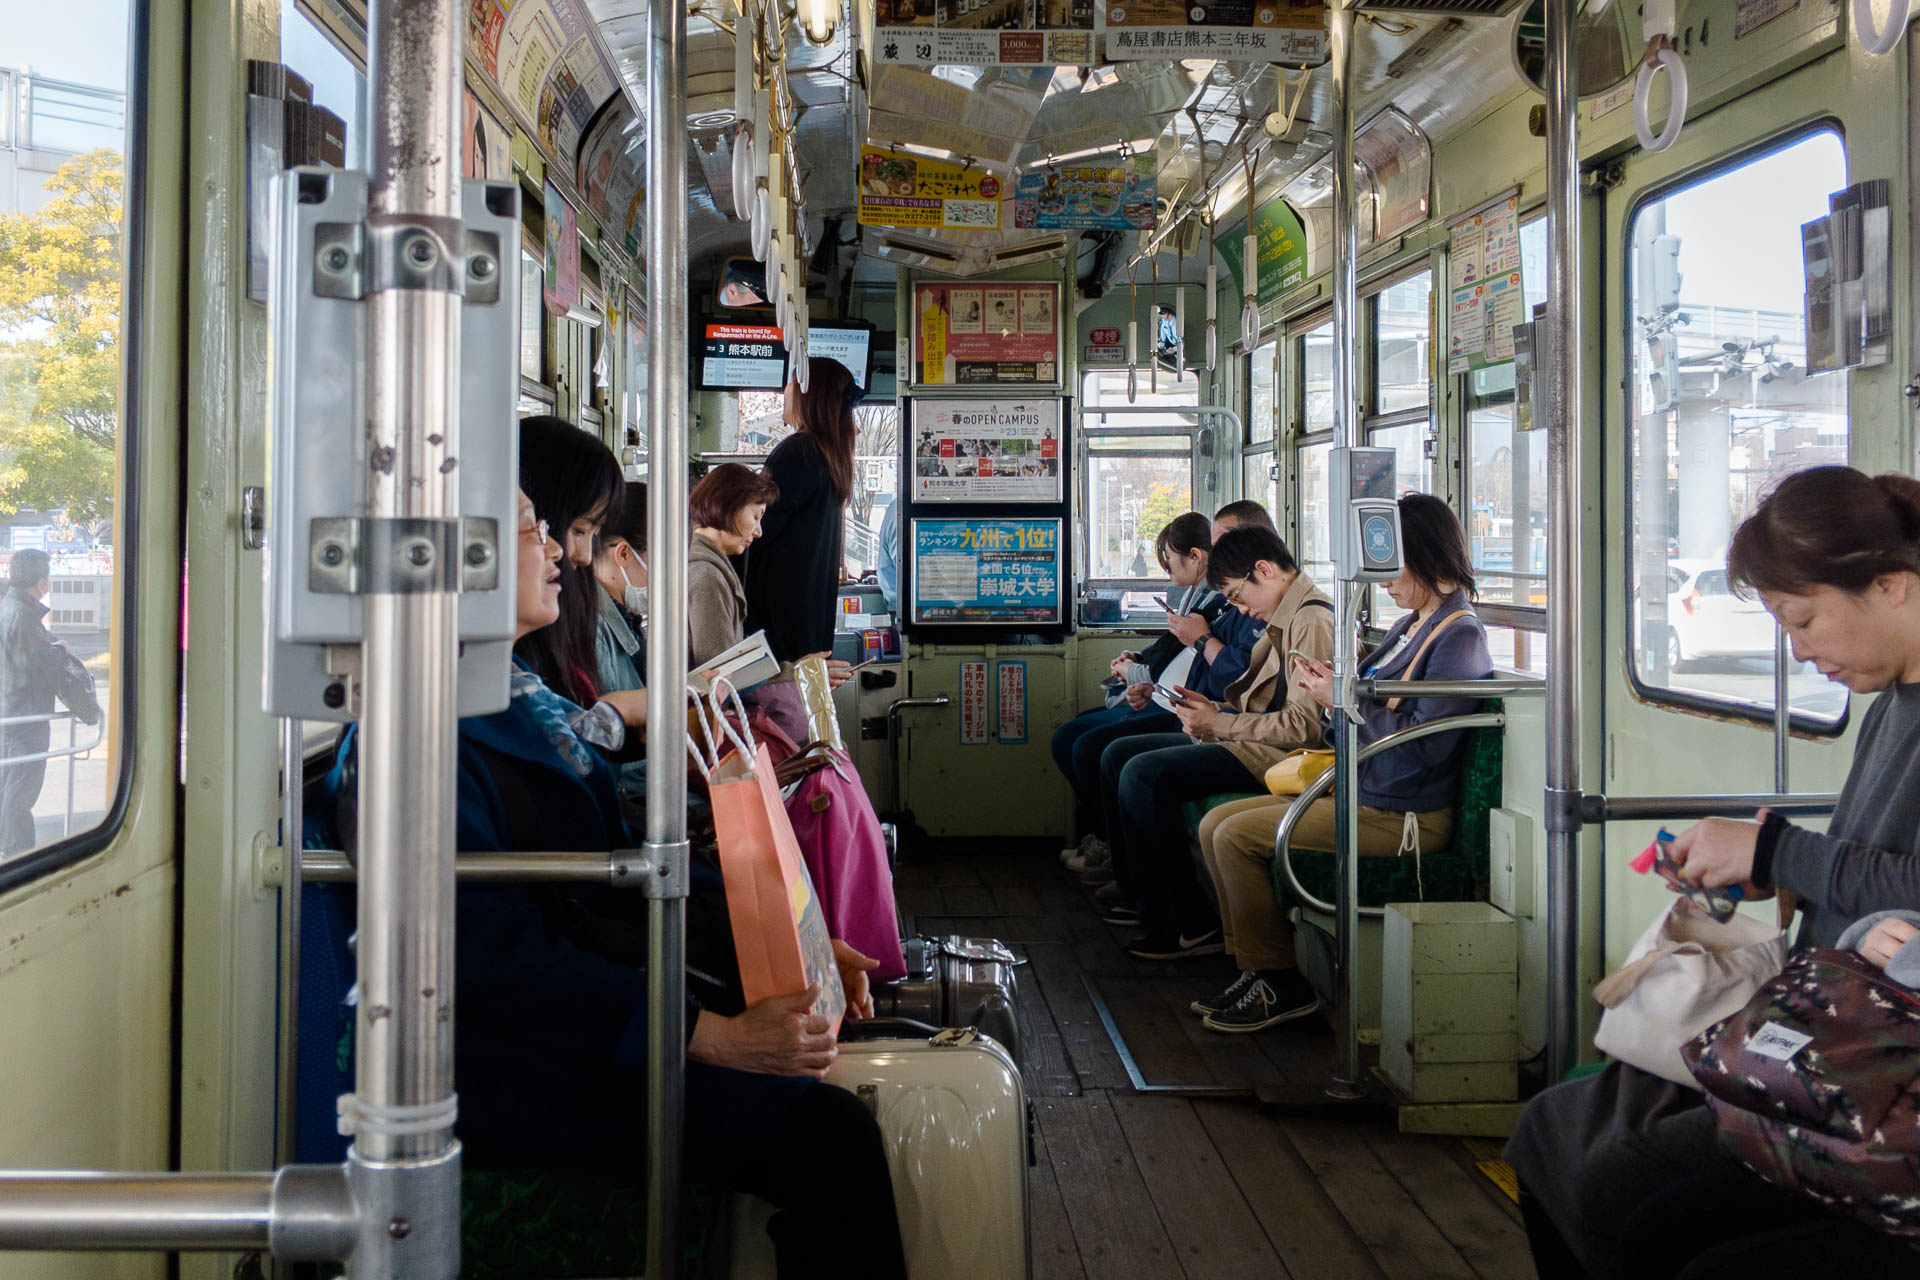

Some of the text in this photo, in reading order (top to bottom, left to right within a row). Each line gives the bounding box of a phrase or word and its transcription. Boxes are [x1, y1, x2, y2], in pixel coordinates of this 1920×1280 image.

[1192, 10, 1203, 18] 1F
[1116, 31, 1267, 48] 蔦屋書店熊本三年坂
[1093, 330, 1117, 344] 禁煙
[718, 344, 725, 353] 3
[728, 344, 773, 357] 熊本駅前
[998, 414, 1039, 425] CAMPUS
[1000, 427, 1017, 437] 3/23
[919, 537, 958, 546] ランキング
[979, 577, 1055, 597] 崇城大学
[975, 663, 985, 738] 車内でのチャージは
